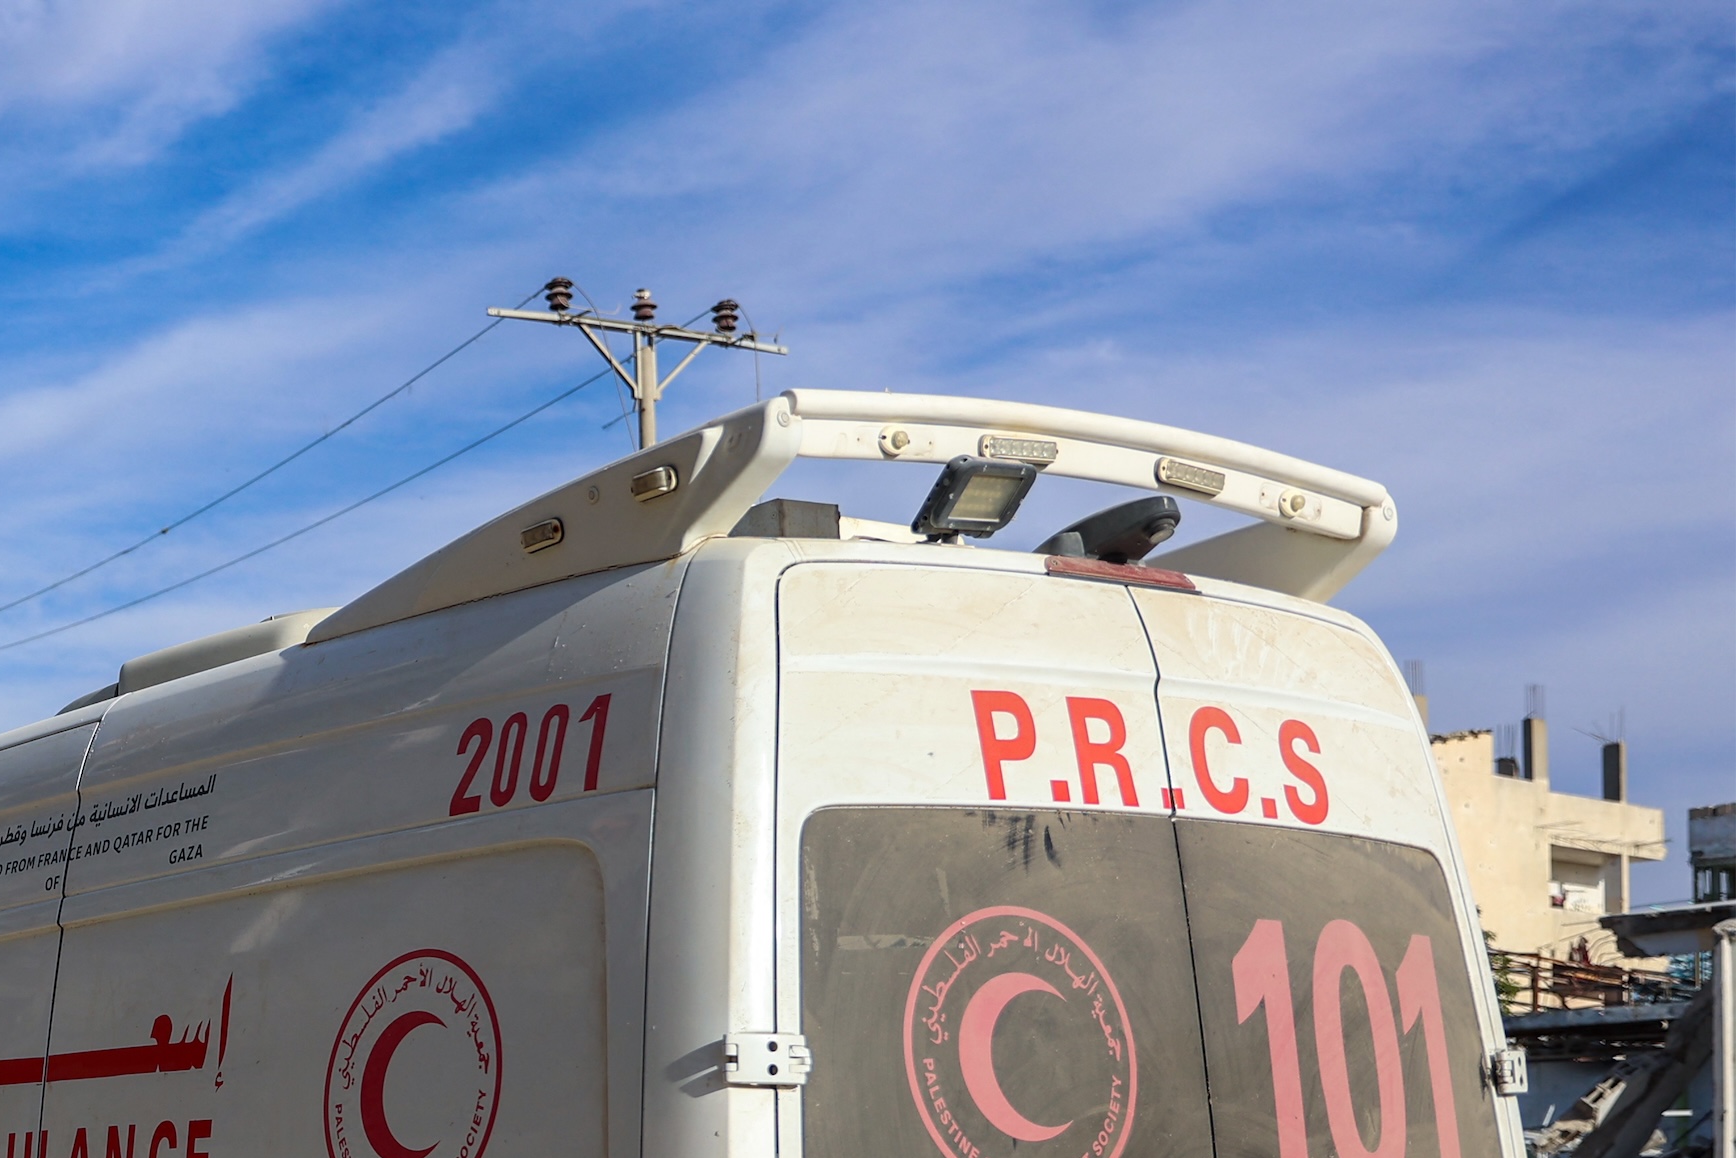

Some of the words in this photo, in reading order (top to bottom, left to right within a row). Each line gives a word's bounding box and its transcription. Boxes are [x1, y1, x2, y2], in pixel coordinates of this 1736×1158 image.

[449, 693, 612, 817] 2001
[971, 690, 1330, 826] P.R.C.S
[89, 793, 143, 828] الانسانية
[144, 773, 216, 811] المساعدات
[5, 857, 35, 876] FROM
[37, 845, 82, 868] FRANCE
[84, 840, 110, 858] AND
[113, 829, 153, 852] QATAR
[155, 823, 181, 843] FOR
[184, 815, 210, 834] THE
[30, 813, 64, 840] فرنسا
[44, 875, 60, 892] OF
[168, 843, 204, 865] GAZA
[1092, 1075, 1122, 1156] SOCIETY
